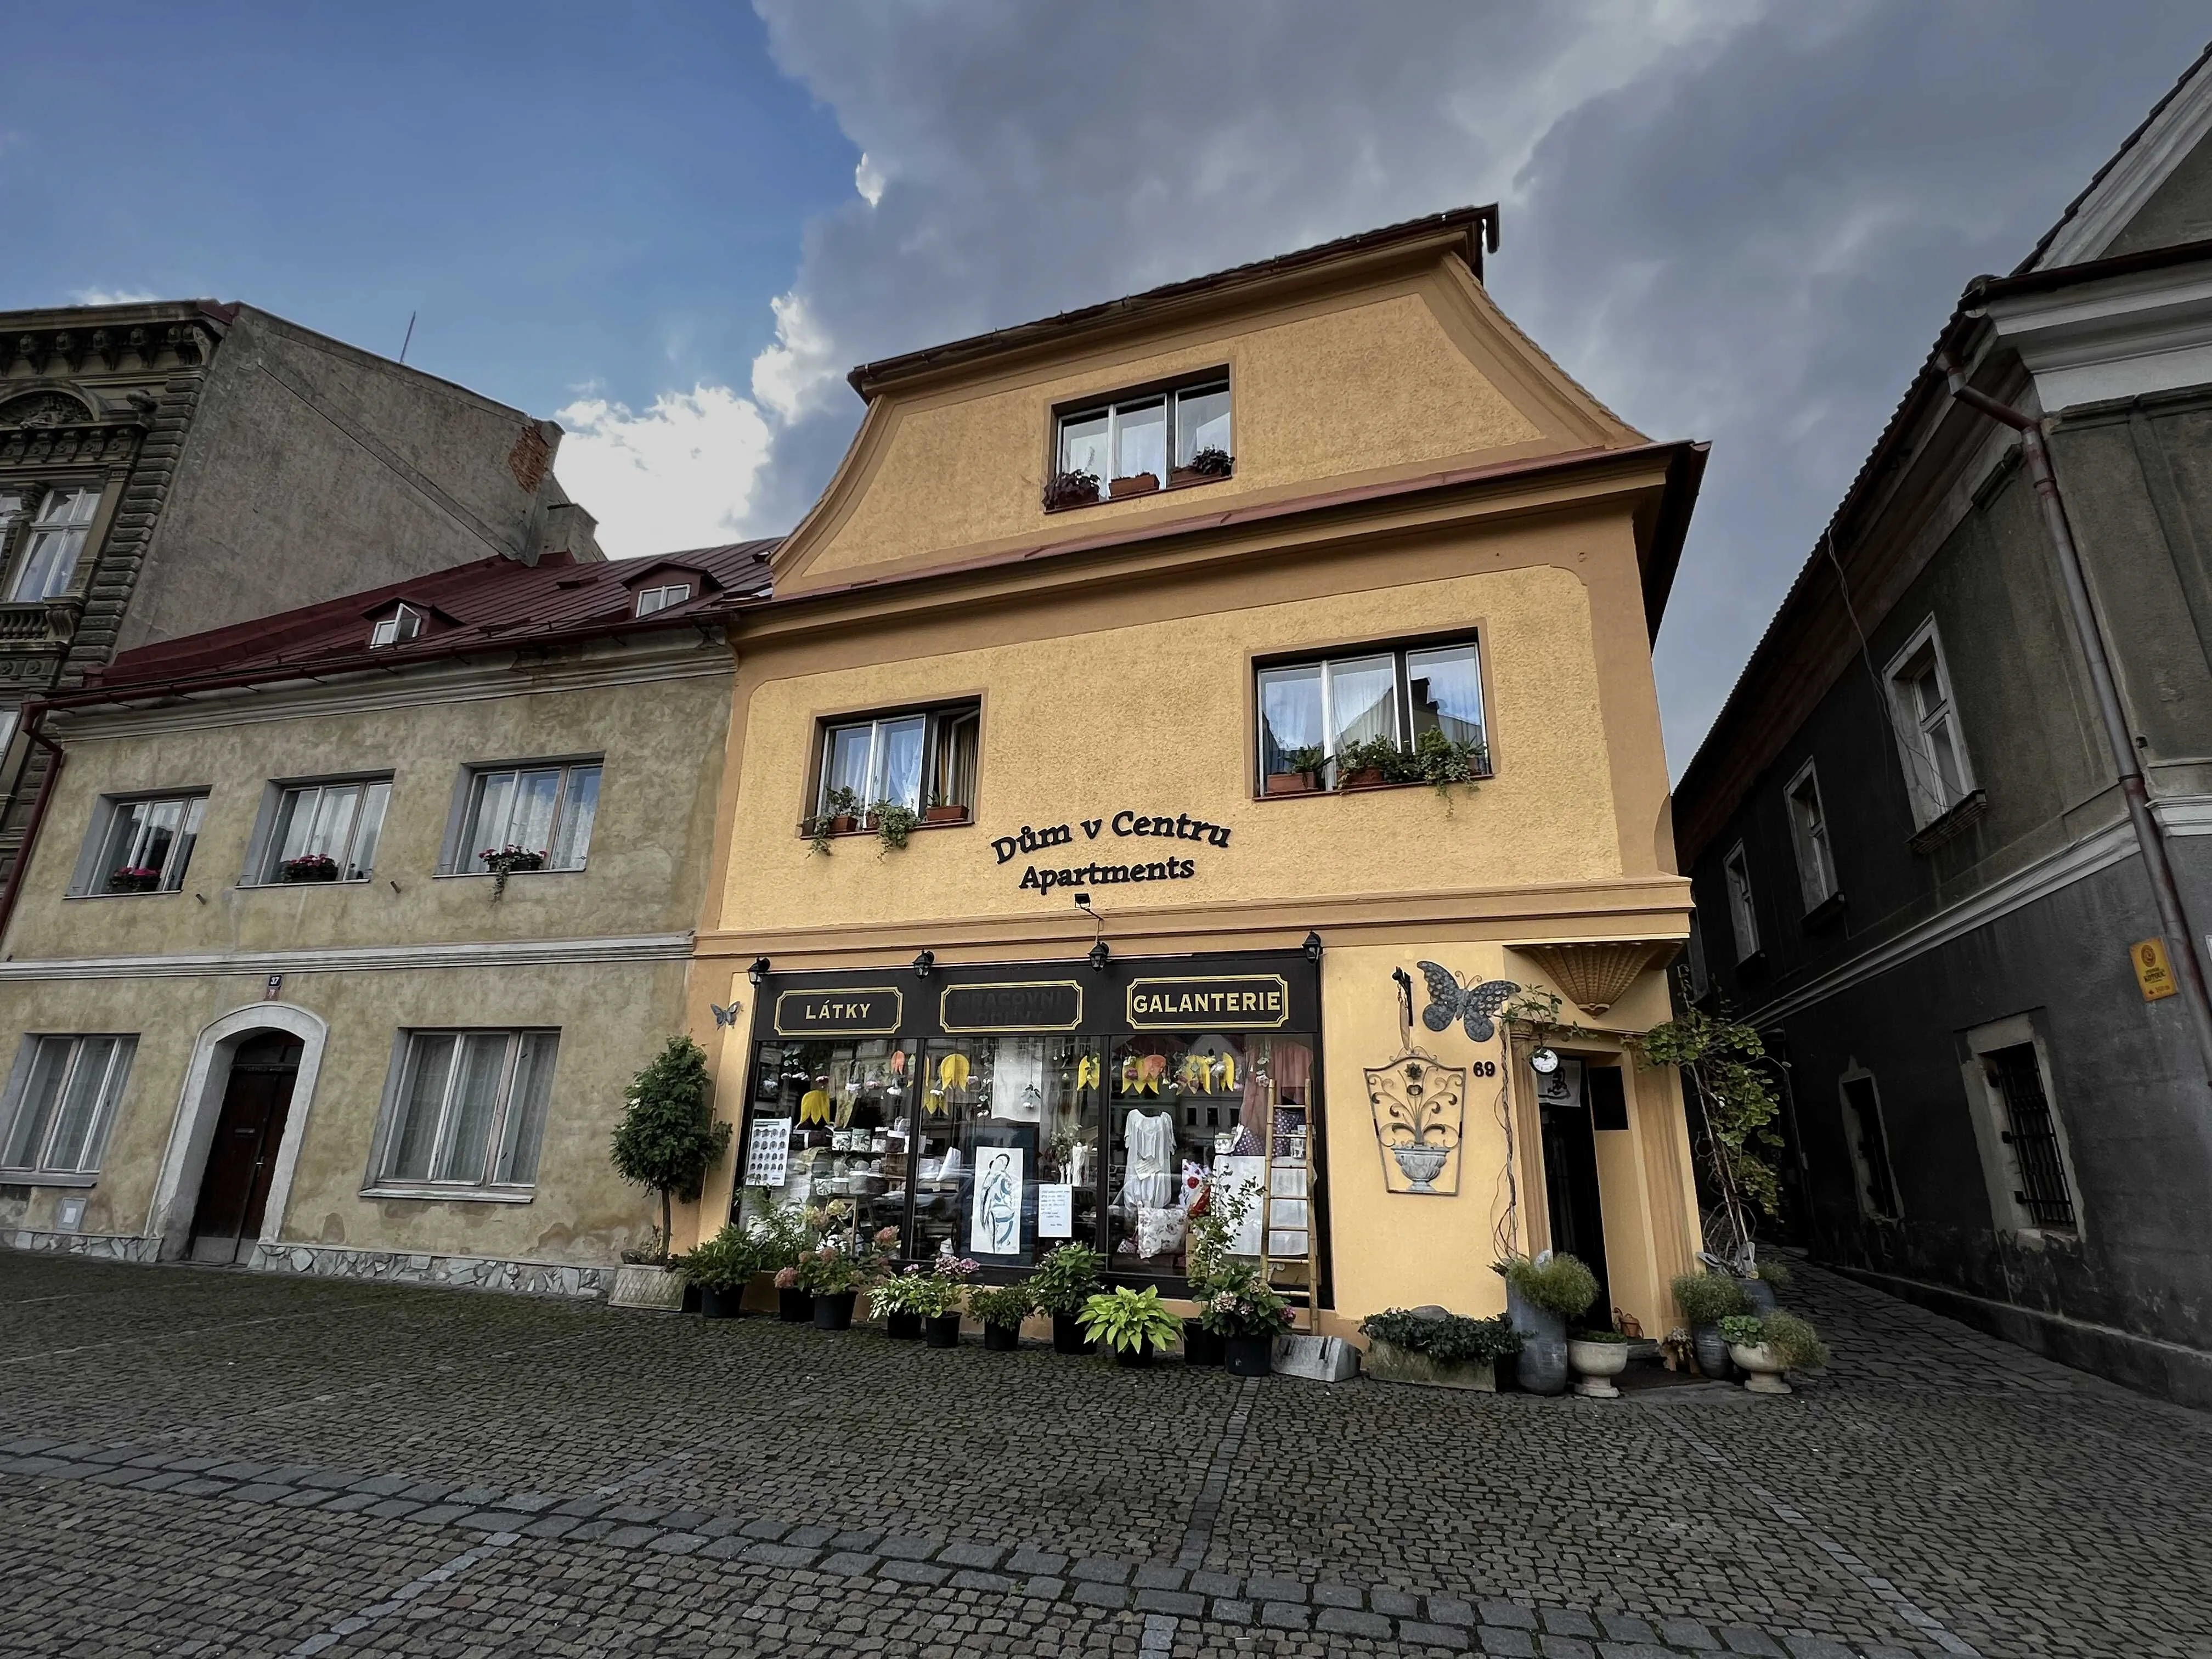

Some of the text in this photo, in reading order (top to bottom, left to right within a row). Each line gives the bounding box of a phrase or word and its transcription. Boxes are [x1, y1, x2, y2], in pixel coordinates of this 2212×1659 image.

[991, 810, 1231, 865] Dům v Centru
[1018, 856, 1194, 895] Apartments
[805, 1000, 871, 1020] LÁTKY
[1133, 991, 1281, 1013] GALANTERIE
[1473, 1061, 1496, 1077] 69
